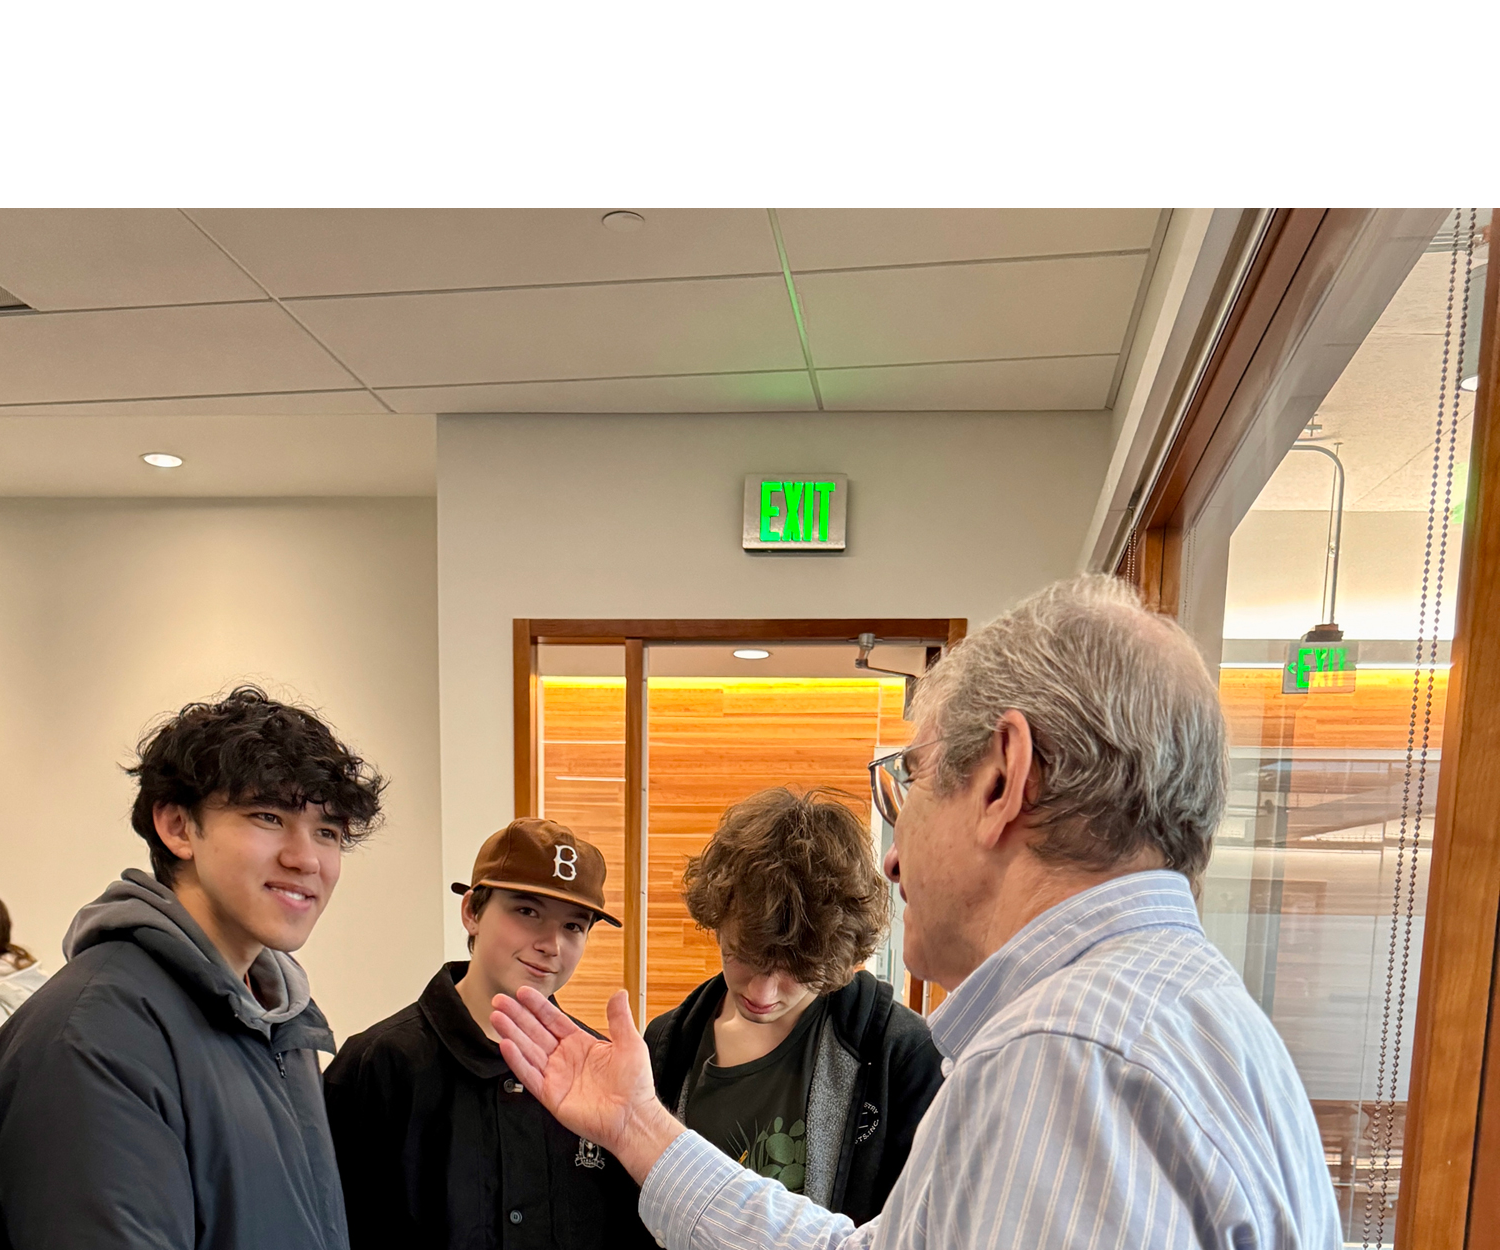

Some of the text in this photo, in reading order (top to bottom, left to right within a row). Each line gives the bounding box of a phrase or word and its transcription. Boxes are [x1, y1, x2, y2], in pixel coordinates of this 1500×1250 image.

[760, 481, 835, 542] EXIT
[1296, 648, 1349, 688] EXIT
[552, 844, 578, 881] B
